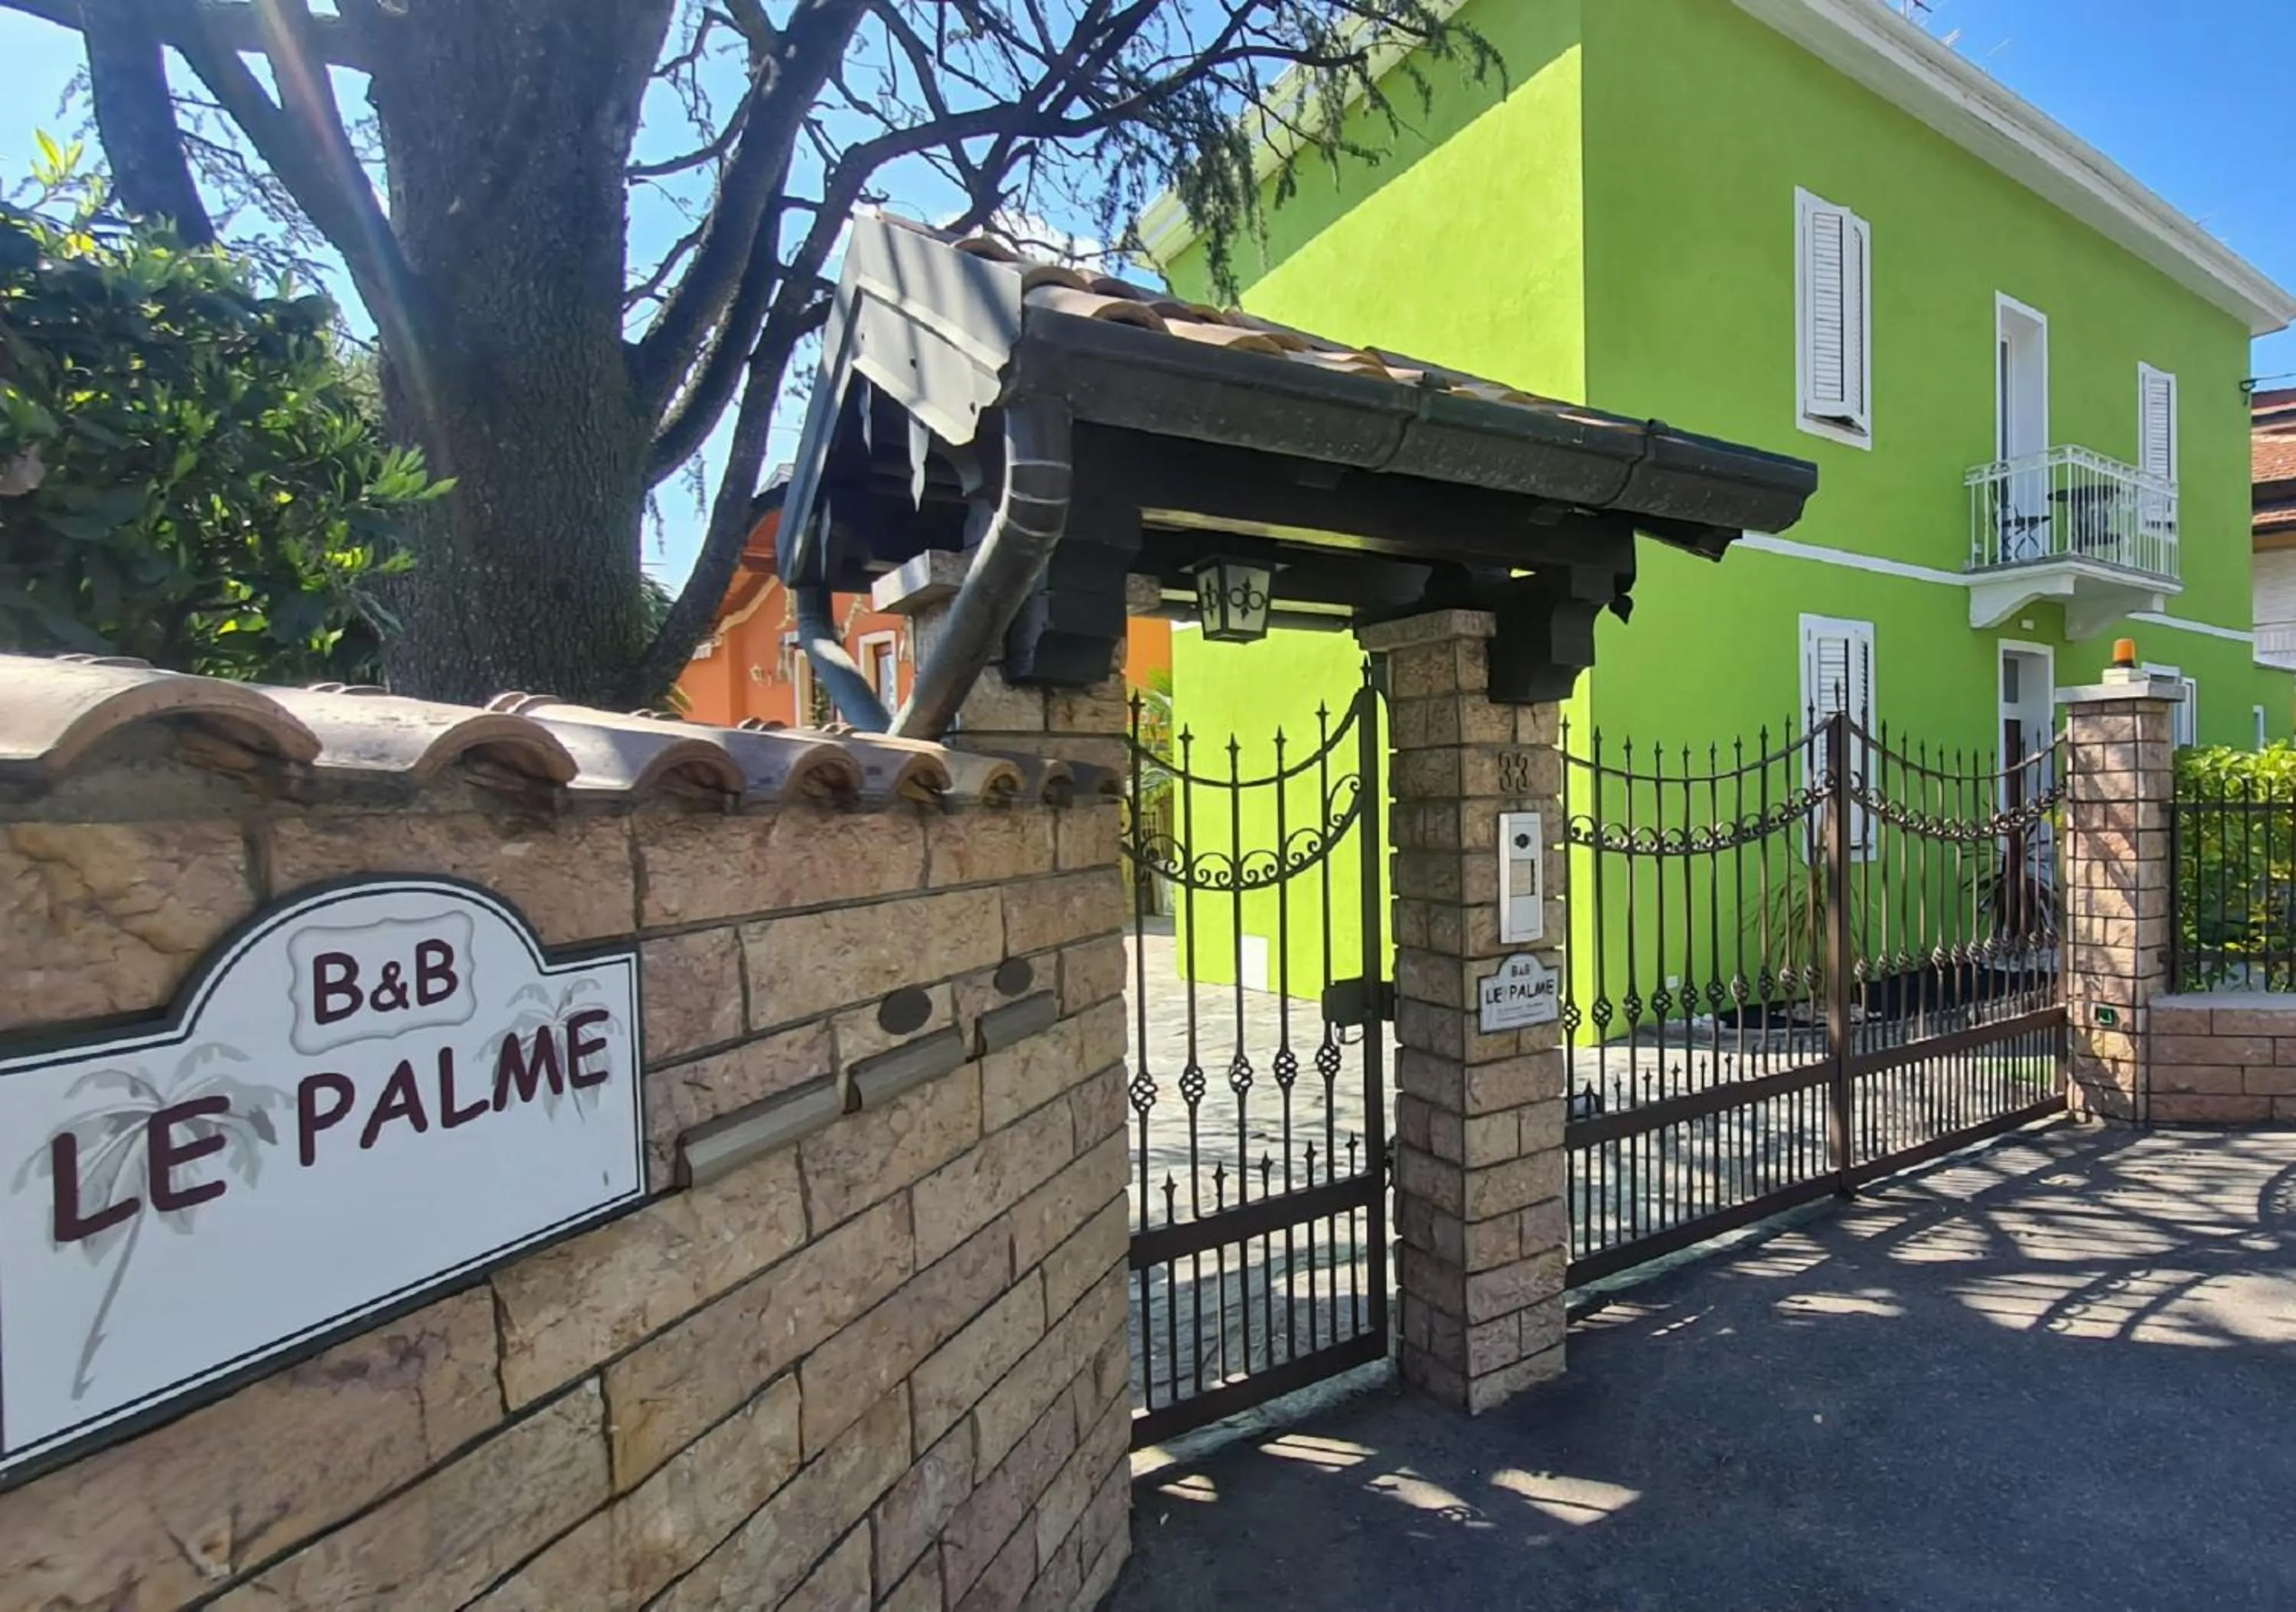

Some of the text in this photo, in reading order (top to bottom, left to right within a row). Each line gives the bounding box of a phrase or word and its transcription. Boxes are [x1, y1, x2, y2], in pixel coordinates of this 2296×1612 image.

[312, 938, 459, 1025] B&B
[1486, 979, 1555, 1004] LE PALME
[51, 1009, 610, 1242] LE PALME
